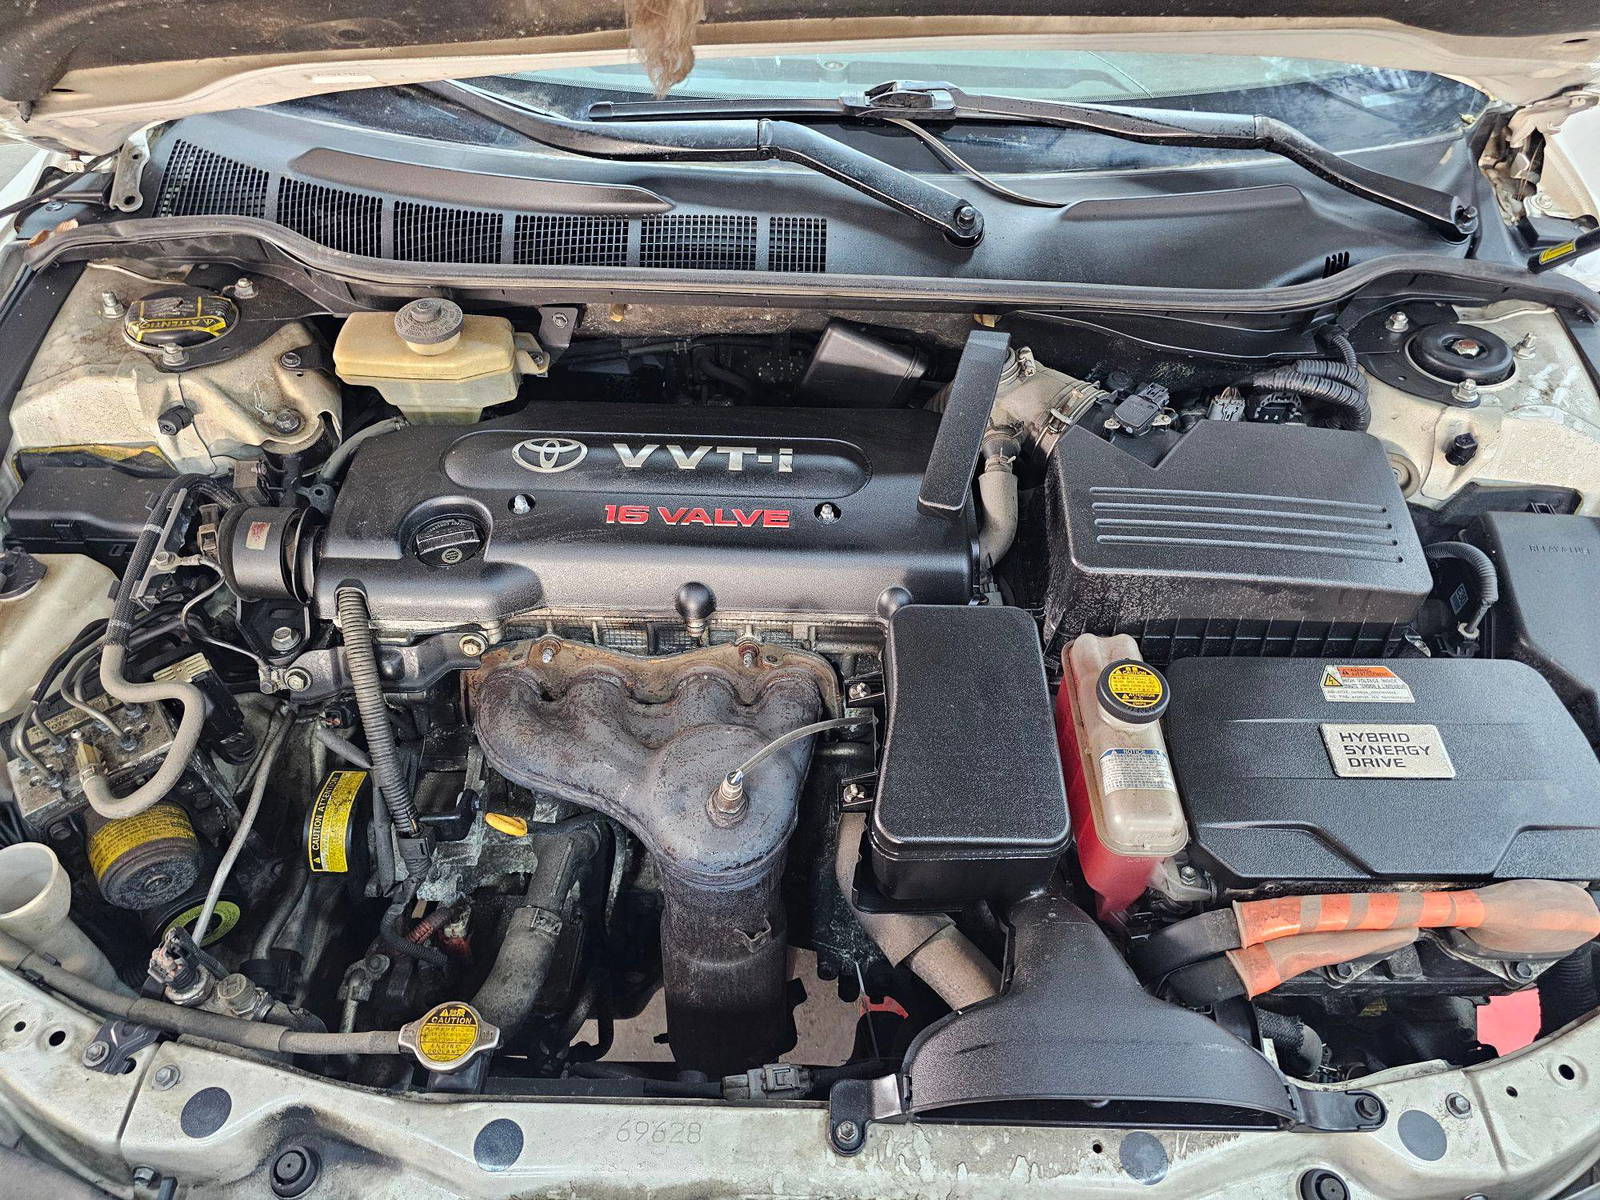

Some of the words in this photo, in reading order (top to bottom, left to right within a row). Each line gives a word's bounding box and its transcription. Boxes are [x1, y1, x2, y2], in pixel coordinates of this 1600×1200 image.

[612, 442, 793, 473] VVT-i
[604, 504, 650, 525] 16
[657, 506, 791, 528] VALVE
[1339, 732, 1411, 743] HYBRID
[1343, 745, 1430, 756] SYNERGY
[1347, 758, 1406, 768] DRIVE
[312, 814, 323, 851] CAUTION
[431, 1016, 472, 1024] CAUTION
[616, 1119, 702, 1144] 69628
